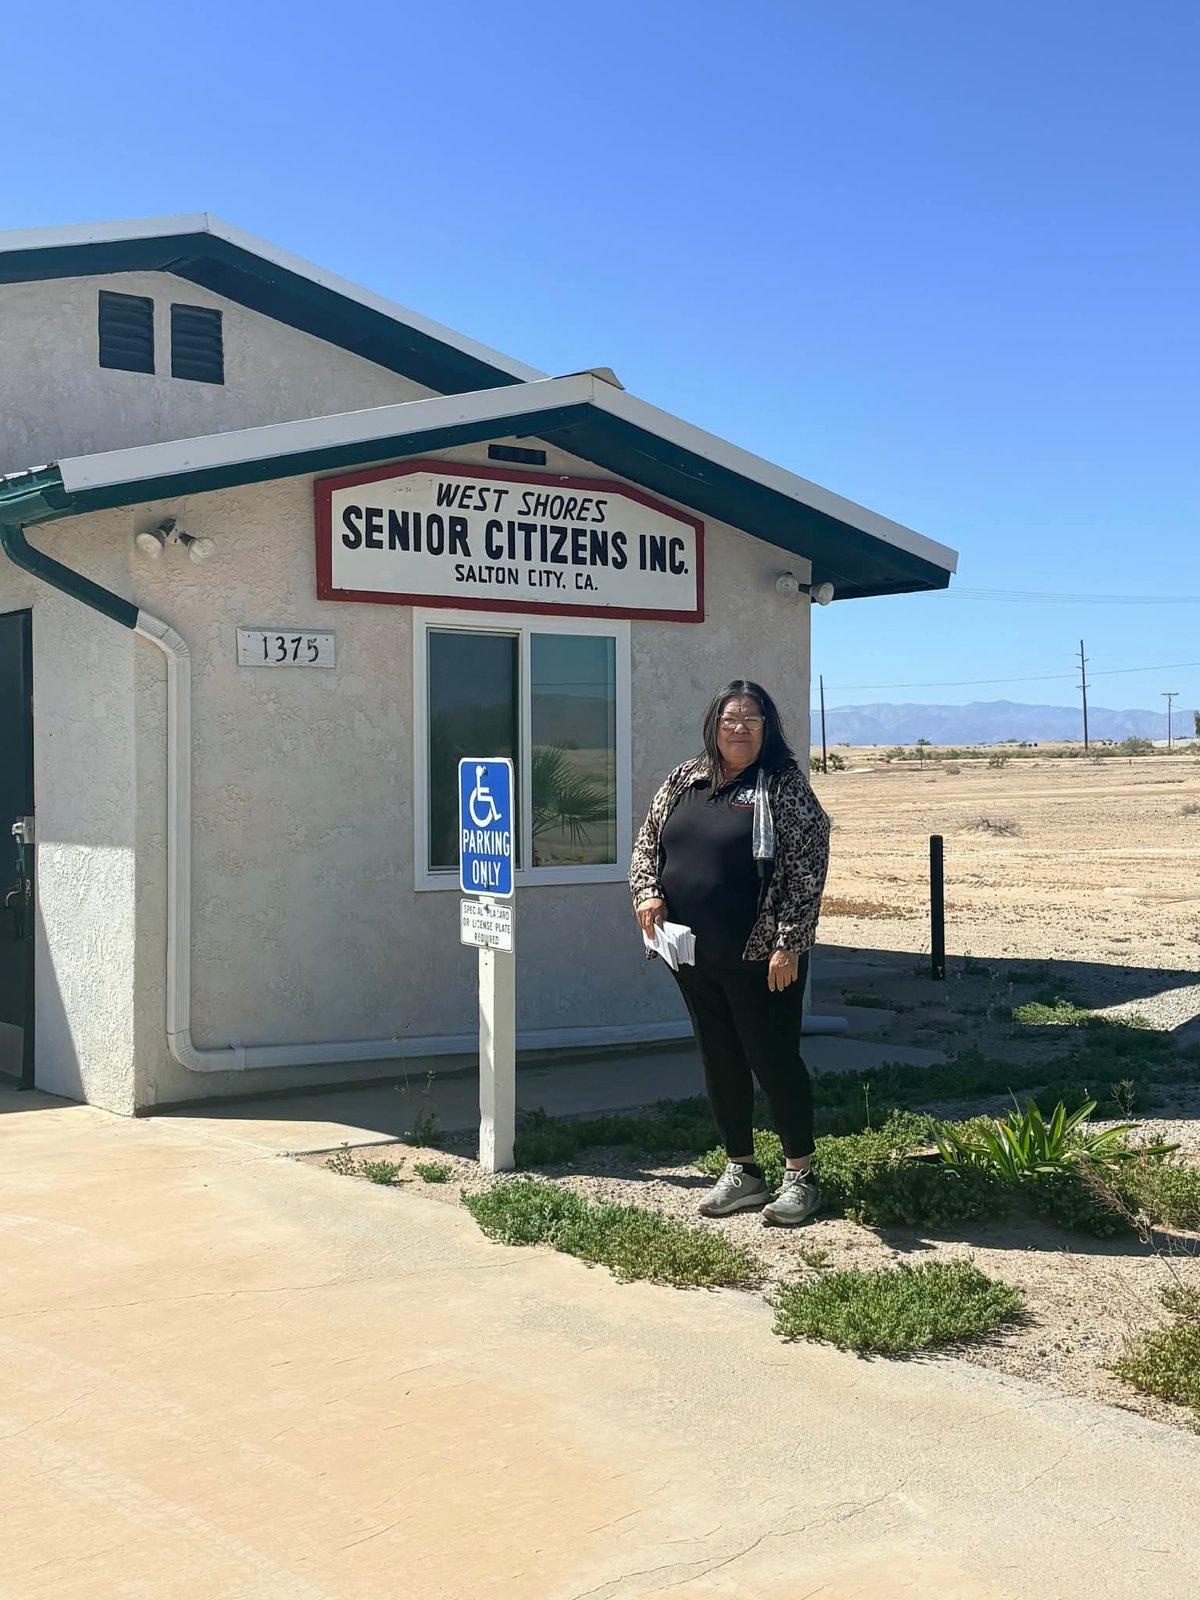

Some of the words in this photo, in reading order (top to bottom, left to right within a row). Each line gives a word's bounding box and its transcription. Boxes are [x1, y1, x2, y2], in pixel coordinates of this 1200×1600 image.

[436, 482, 510, 514] WEST
[517, 491, 608, 524] SHORES
[341, 504, 472, 558] SENIOR
[484, 518, 628, 570] CITIZENS
[638, 534, 689, 576] INC.
[454, 563, 519, 586] SALTON
[527, 568, 567, 591] CITY,
[574, 572, 600, 592] CA.
[262, 636, 319, 663] 1375
[462, 828, 510, 857] PARKING
[472, 859, 501, 888] ONLY
[463, 904, 484, 917] SPECAL
[495, 922, 511, 935] PLATE
